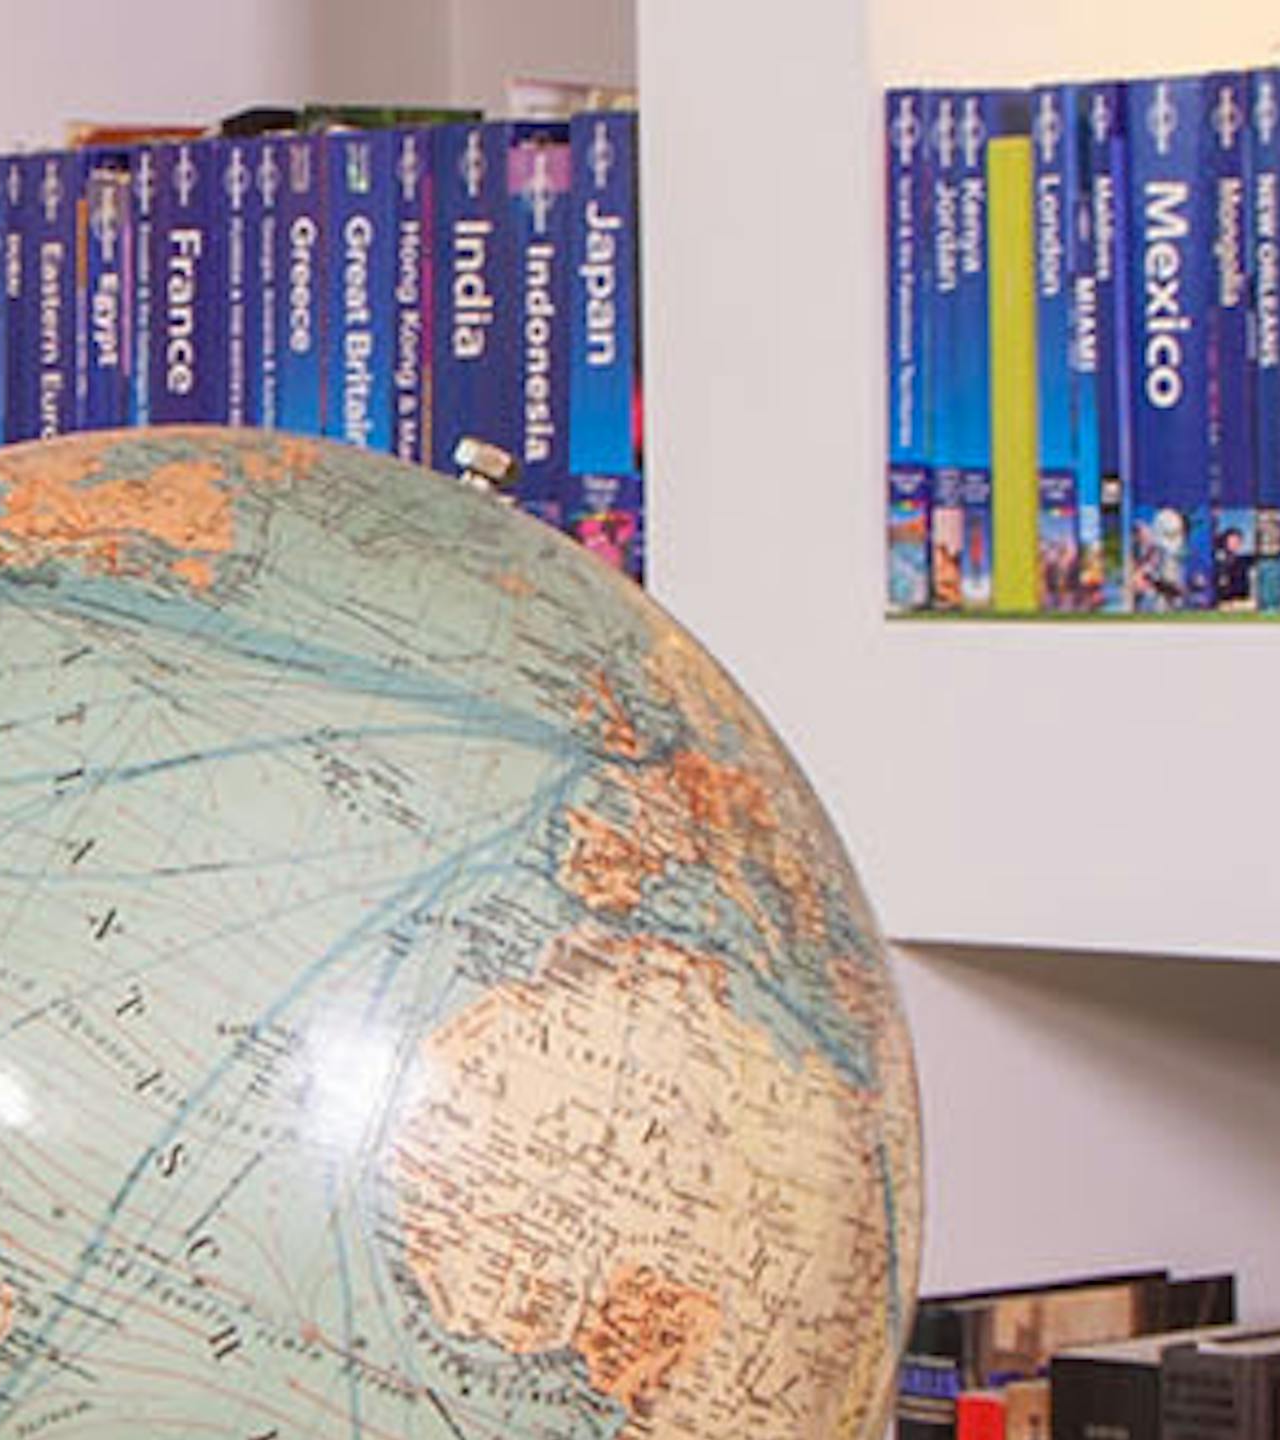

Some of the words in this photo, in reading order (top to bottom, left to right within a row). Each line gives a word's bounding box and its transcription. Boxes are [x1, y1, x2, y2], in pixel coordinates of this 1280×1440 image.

[289, 215, 318, 354] Greece
[345, 215, 372, 324] Great
[395, 220, 421, 304] Hong
[578, 199, 622, 365] Japan
[934, 179, 958, 293] Jordan
[960, 176, 983, 274] Kenya
[1037, 173, 1062, 297] London
[1215, 177, 1243, 309] Mongolia
[40, 241, 63, 365] Eastern
[92, 271, 119, 367] Egypt
[166, 228, 202, 395] France
[395, 311, 421, 388] Kong
[454, 219, 494, 358] India
[1074, 276, 1096, 373] MIAMI
[1143, 179, 1192, 410] Mexico
[40, 372, 63, 440] Euro
[523, 244, 554, 463] Indonesia
